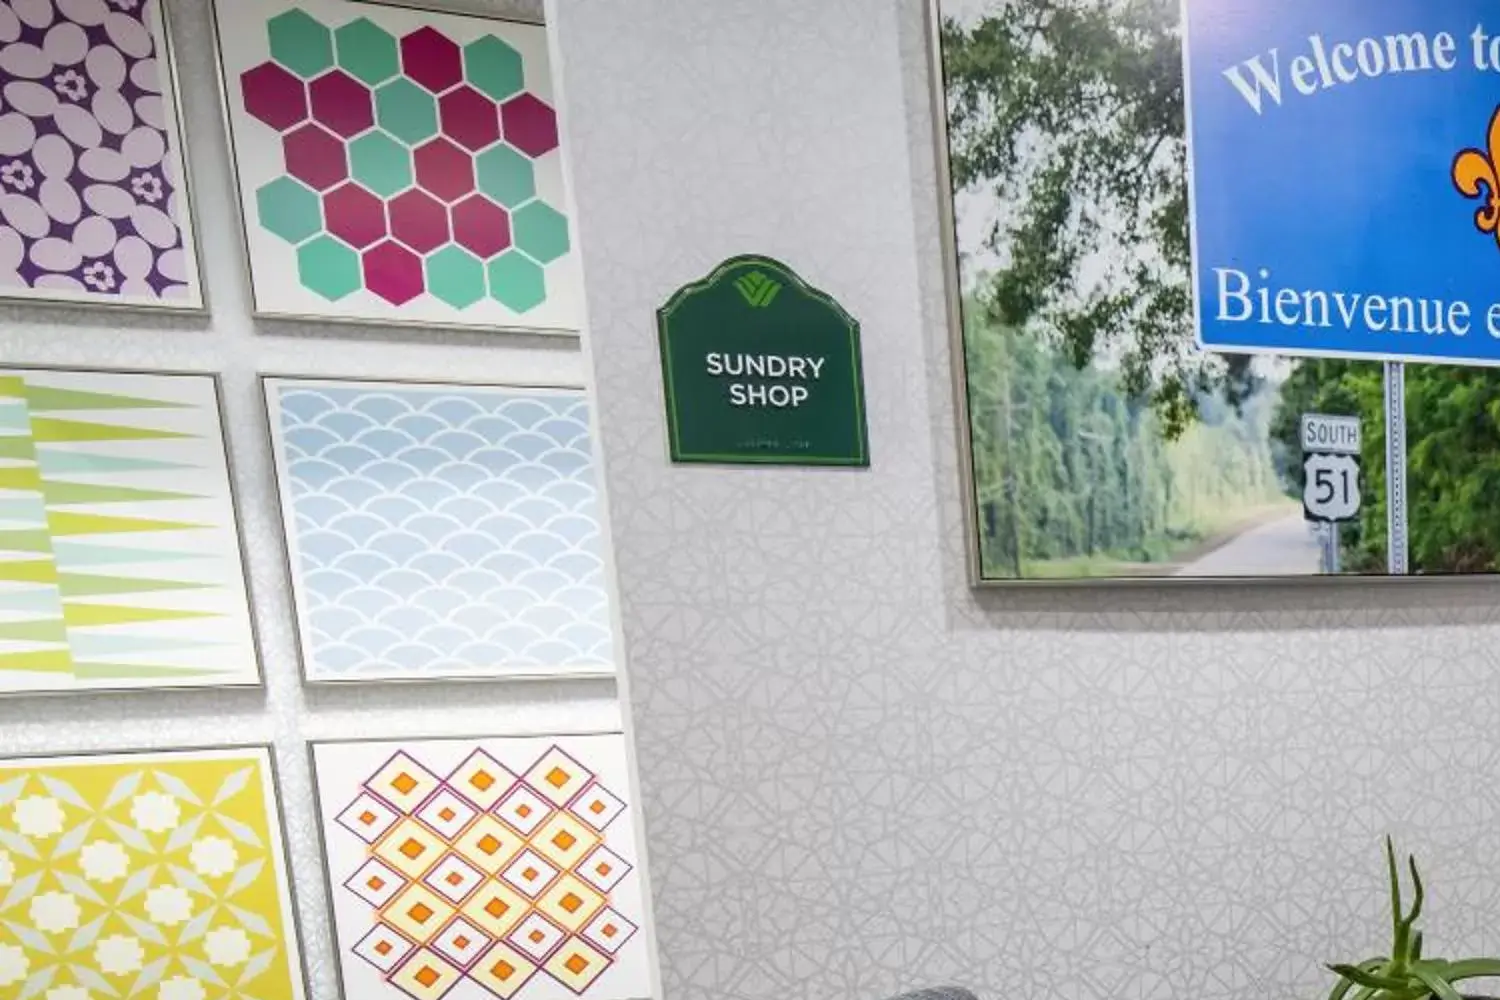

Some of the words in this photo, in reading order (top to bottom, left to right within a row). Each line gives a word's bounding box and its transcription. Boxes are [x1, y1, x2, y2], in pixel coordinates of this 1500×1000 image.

[1222, 26, 1456, 116] Welcome
[1214, 267, 1470, 337] Bienvenue
[706, 352, 825, 378] SUNDRY
[730, 383, 808, 407] SHOP
[1307, 421, 1356, 443] SOUTH
[1315, 469, 1349, 505] 51
